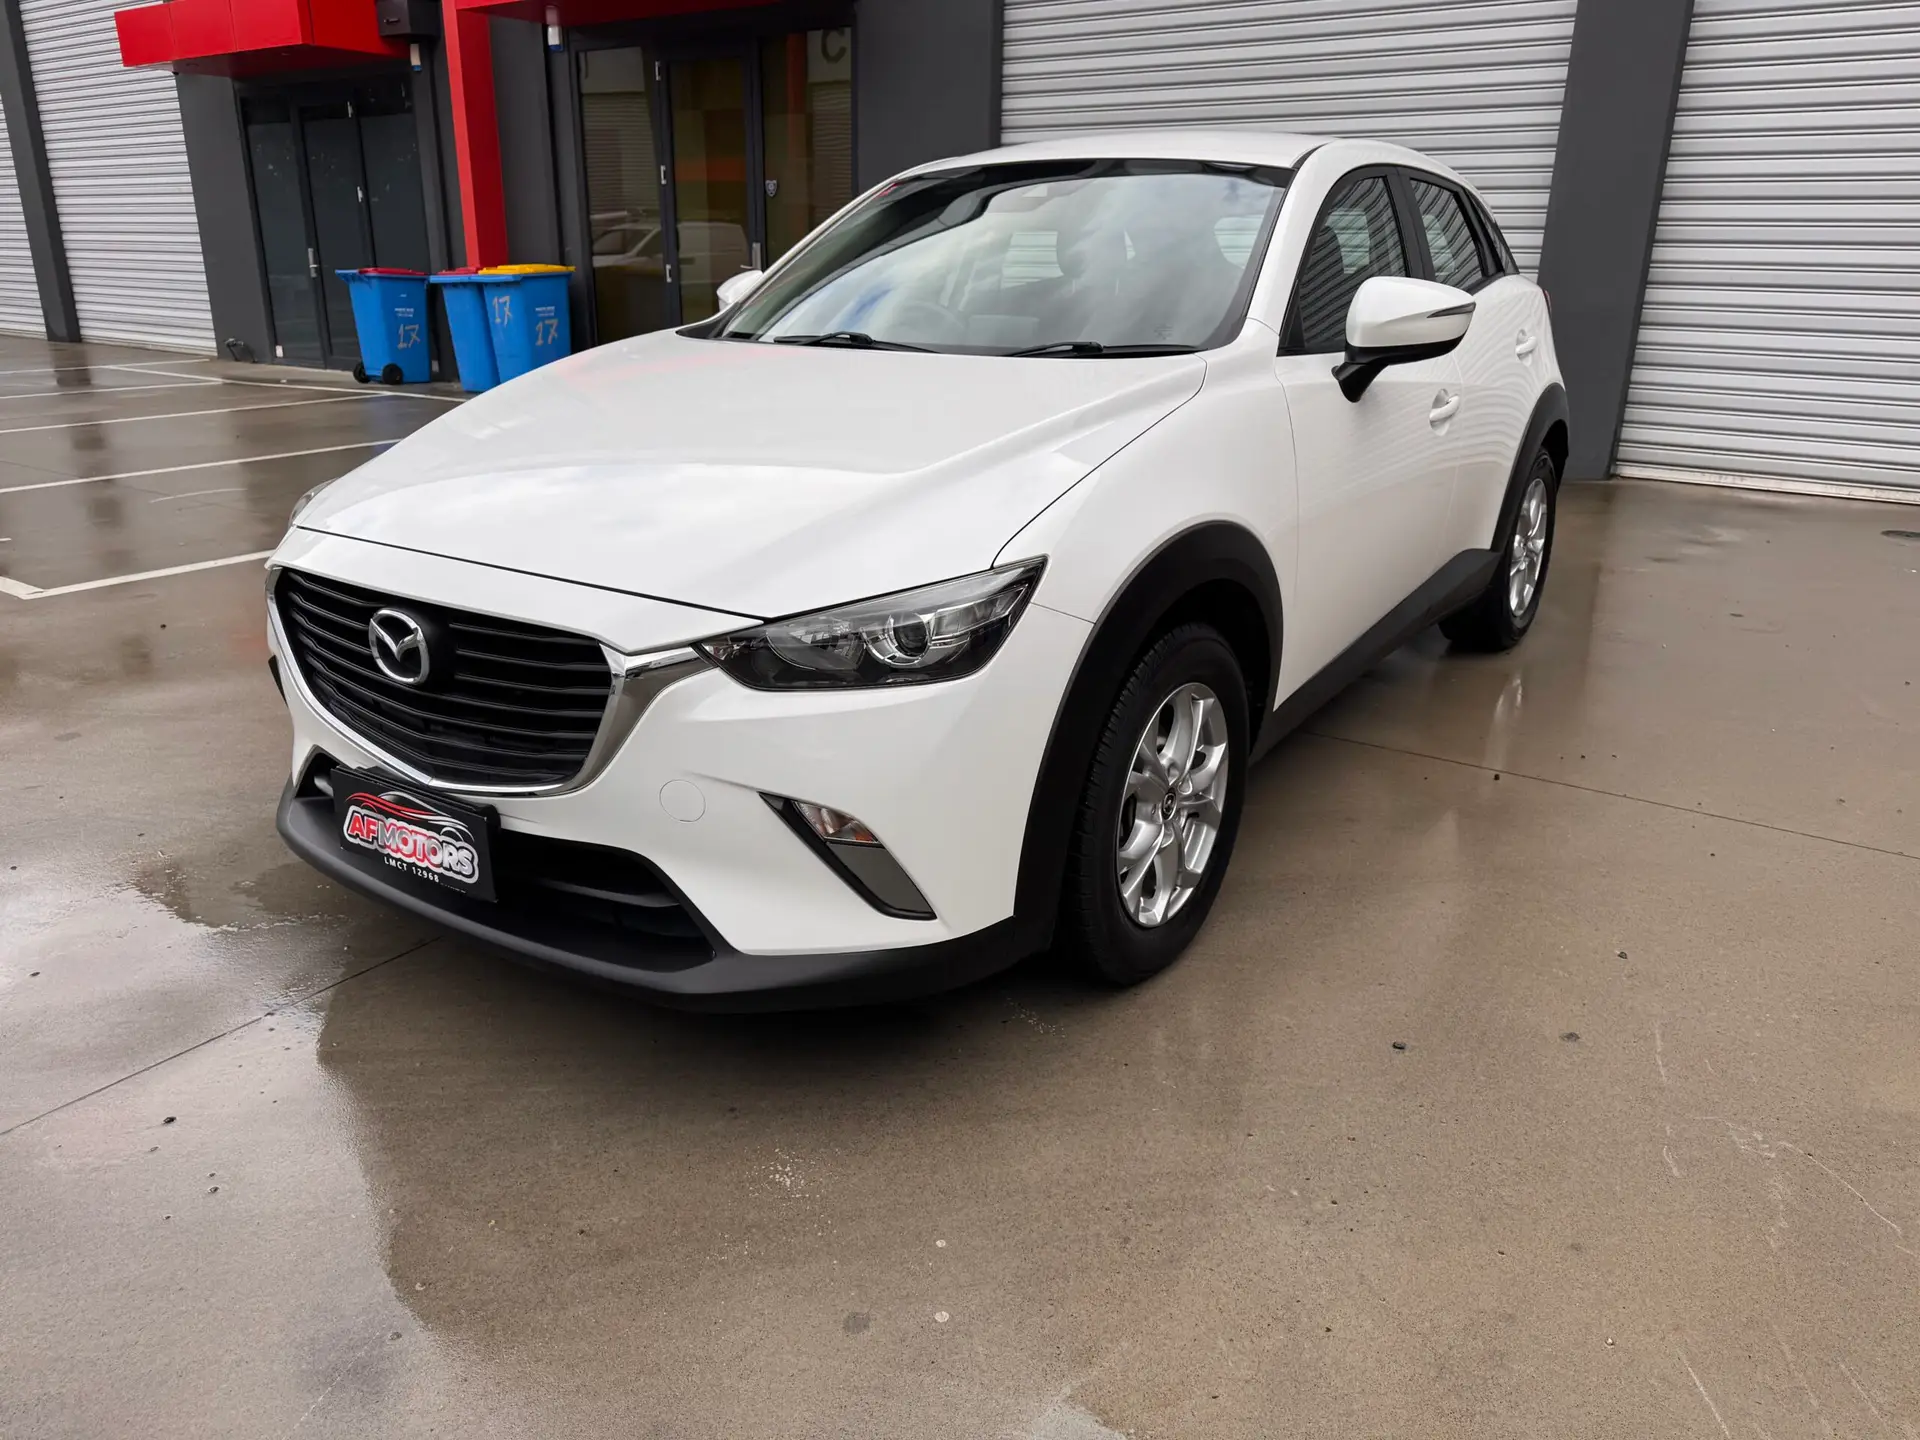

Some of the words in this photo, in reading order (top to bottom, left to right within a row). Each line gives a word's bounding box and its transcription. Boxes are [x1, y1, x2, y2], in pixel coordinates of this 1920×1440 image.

[492, 295, 513, 327] 17
[397, 324, 421, 349] 17
[535, 319, 559, 346] 17
[383, 856, 408, 872] LMCT
[411, 866, 440, 883] 12968
